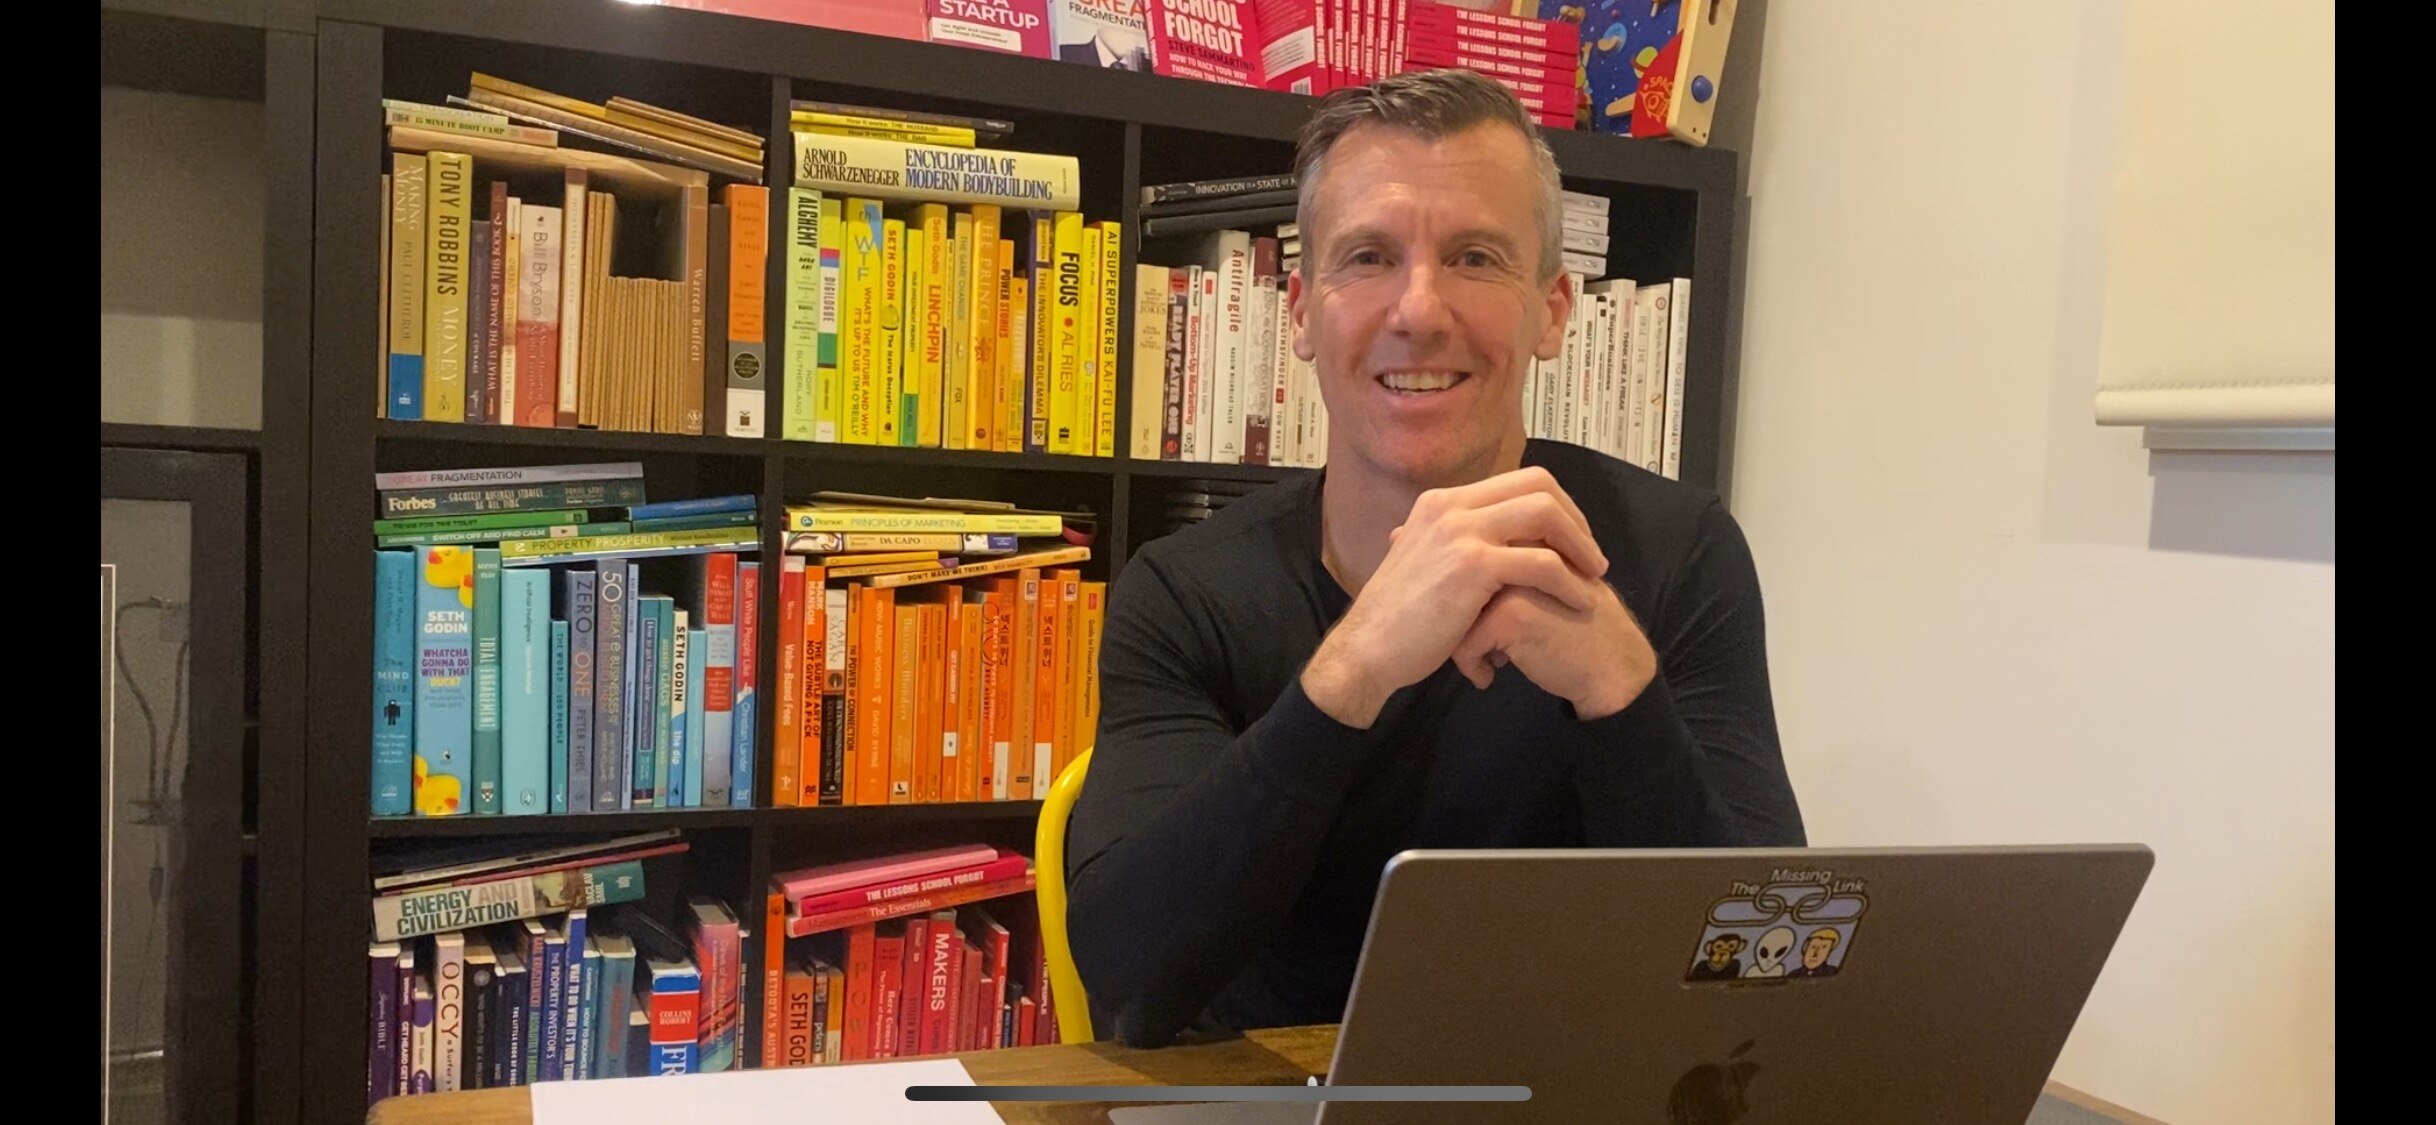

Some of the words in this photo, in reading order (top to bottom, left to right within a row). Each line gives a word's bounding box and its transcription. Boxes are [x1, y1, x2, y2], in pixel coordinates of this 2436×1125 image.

[940, 1, 1039, 29] STARTUP
[1469, 12, 1496, 24] LESSONS
[1498, 17, 1521, 28] SCHOOL
[1522, 21, 1546, 32] FORGOT
[1164, 10, 1243, 57] FORGOT
[1469, 28, 1496, 40] LESSONS
[1498, 32, 1521, 44] SCHOOL
[1523, 36, 1546, 47] FORGOT
[1379, 51, 1389, 81] FORGOT
[1469, 43, 1496, 55] LESSONS
[1498, 48, 1521, 59] SCHOOL
[1522, 52, 1546, 63] FORGOT
[1469, 59, 1496, 71] LESSONS
[1497, 63, 1521, 75] SCHOOL
[1522, 67, 1544, 78] FORGOT
[804, 148, 847, 167] ARNOLD
[905, 149, 997, 174] ENCYCLOPEDIA
[1001, 158, 1016, 176] OF
[440, 160, 461, 208] TONY
[802, 164, 899, 186] SCHWARZENEGGER
[906, 168, 959, 189] MODERN
[963, 175, 1053, 200] BODYBUILDING
[1196, 182, 1246, 194] INNOVATION
[797, 197, 818, 248] ALCHEMY
[931, 218, 941, 241] Seth
[492, 229, 501, 255] BOOK
[533, 232, 548, 258] Bill
[886, 230, 897, 260] SETH
[1107, 230, 1117, 244] AI
[437, 216, 459, 296] ROBBINS
[491, 258, 500, 280] THIS
[931, 244, 941, 274] Godin
[491, 284, 500, 295] OF
[531, 262, 547, 316] Bryson
[692, 269, 703, 313] Warren
[886, 263, 896, 300] GODIN
[1060, 252, 1080, 306] FOCUS
[1228, 249, 1245, 332] Antifragile
[490, 299, 499, 326] NAME
[1104, 250, 1117, 354] SUPERPOWERS
[854, 328, 862, 341] UP
[926, 284, 942, 363] LINCHPIN
[1169, 306, 1184, 351] READY
[440, 307, 459, 387] MONEY
[490, 330, 498, 347] THE
[691, 318, 702, 362] Buffett
[854, 343, 862, 356] TO
[862, 328, 871, 347] THE
[1062, 331, 1074, 351] AL
[489, 350, 498, 358] IS
[853, 359, 862, 372] US
[488, 361, 498, 390] WHAT
[861, 349, 871, 387] FUTURE
[1060, 355, 1073, 392] RIES
[1565, 343, 1574, 398] BLOCKCHAIN
[852, 374, 861, 391] TIM
[885, 376, 894, 414] Deception
[861, 389, 870, 410] AND
[851, 394, 861, 436] O'REILLY
[860, 412, 870, 437] WHY
[1102, 412, 1112, 436] LEE
[431, 471, 522, 482] FRAGMENTATION
[389, 496, 436, 512] Forbes
[532, 538, 593, 550] PROPERTY
[596, 534, 665, 548] PROSPERITY
[894, 537, 920, 545] CAPO
[602, 571, 622, 603] 50
[744, 578, 754, 598] Stuff
[816, 580, 824, 610] MARK
[428, 611, 464, 622] SETH
[576, 581, 593, 634] ZERO
[744, 600, 754, 624] White
[807, 580, 817, 626] MANSON
[424, 622, 468, 634] GODIN
[610, 603, 620, 638] GREAT
[480, 637, 496, 664] TOTAL
[646, 640, 653, 648] to
[676, 626, 686, 658] SETH
[741, 627, 753, 656] People
[806, 640, 814, 662] NOT
[814, 641, 822, 660] THE
[874, 624, 884, 654] MUSIC
[902, 618, 913, 664] Business
[422, 658, 454, 668] GONNA
[458, 658, 470, 667] DO
[423, 648, 468, 658] WHATCHA
[377, 671, 409, 680] MIND
[421, 668, 444, 678] WITH
[448, 667, 470, 676] THAT
[574, 652, 591, 698] ONE
[743, 658, 752, 677] Like
[806, 664, 814, 698] GIVING
[814, 662, 822, 699] SUBTLE
[848, 657, 856, 688] POWER
[874, 656, 883, 690] WORKS
[660, 673, 670, 706] GAGS
[674, 663, 684, 702] GODIN
[480, 668, 496, 728] ENGAGEMENT
[1084, 676, 1094, 718] Management
[741, 702, 750, 740] Christian
[782, 704, 793, 726] Fees
[813, 702, 821, 720] ART
[872, 710, 880, 736] DAVID
[812, 725, 820, 738] OF
[846, 699, 856, 752] CONNECTION
[673, 731, 682, 748] the
[870, 740, 880, 768] BYRNE
[867, 890, 881, 901] THE
[883, 883, 919, 898] LESSONS
[1732, 882, 1760, 896] The
[1771, 869, 1832, 884] Missing
[1833, 880, 1864, 893] Link
[400, 889, 472, 917] ENERGY
[479, 882, 518, 904] AND
[870, 906, 887, 918] The
[889, 898, 932, 914] Essentials
[396, 900, 519, 936] CIVILIZATION
[570, 964, 580, 982] WHAT
[930, 933, 950, 1012] MAKERS
[441, 962, 460, 1039] OCCY
[549, 966, 560, 1008] PROPERTY
[568, 984, 580, 994] TO
[568, 996, 578, 1006] DO
[660, 1010, 692, 1018] COLLINS
[790, 992, 808, 1030] SETH
[887, 990, 896, 1014] Here
[566, 1006, 578, 1028] WHEN
[660, 1017, 691, 1026] ROBERT
[546, 1010, 558, 1058] INVESTOR'S
[582, 1028, 590, 1038] TO
